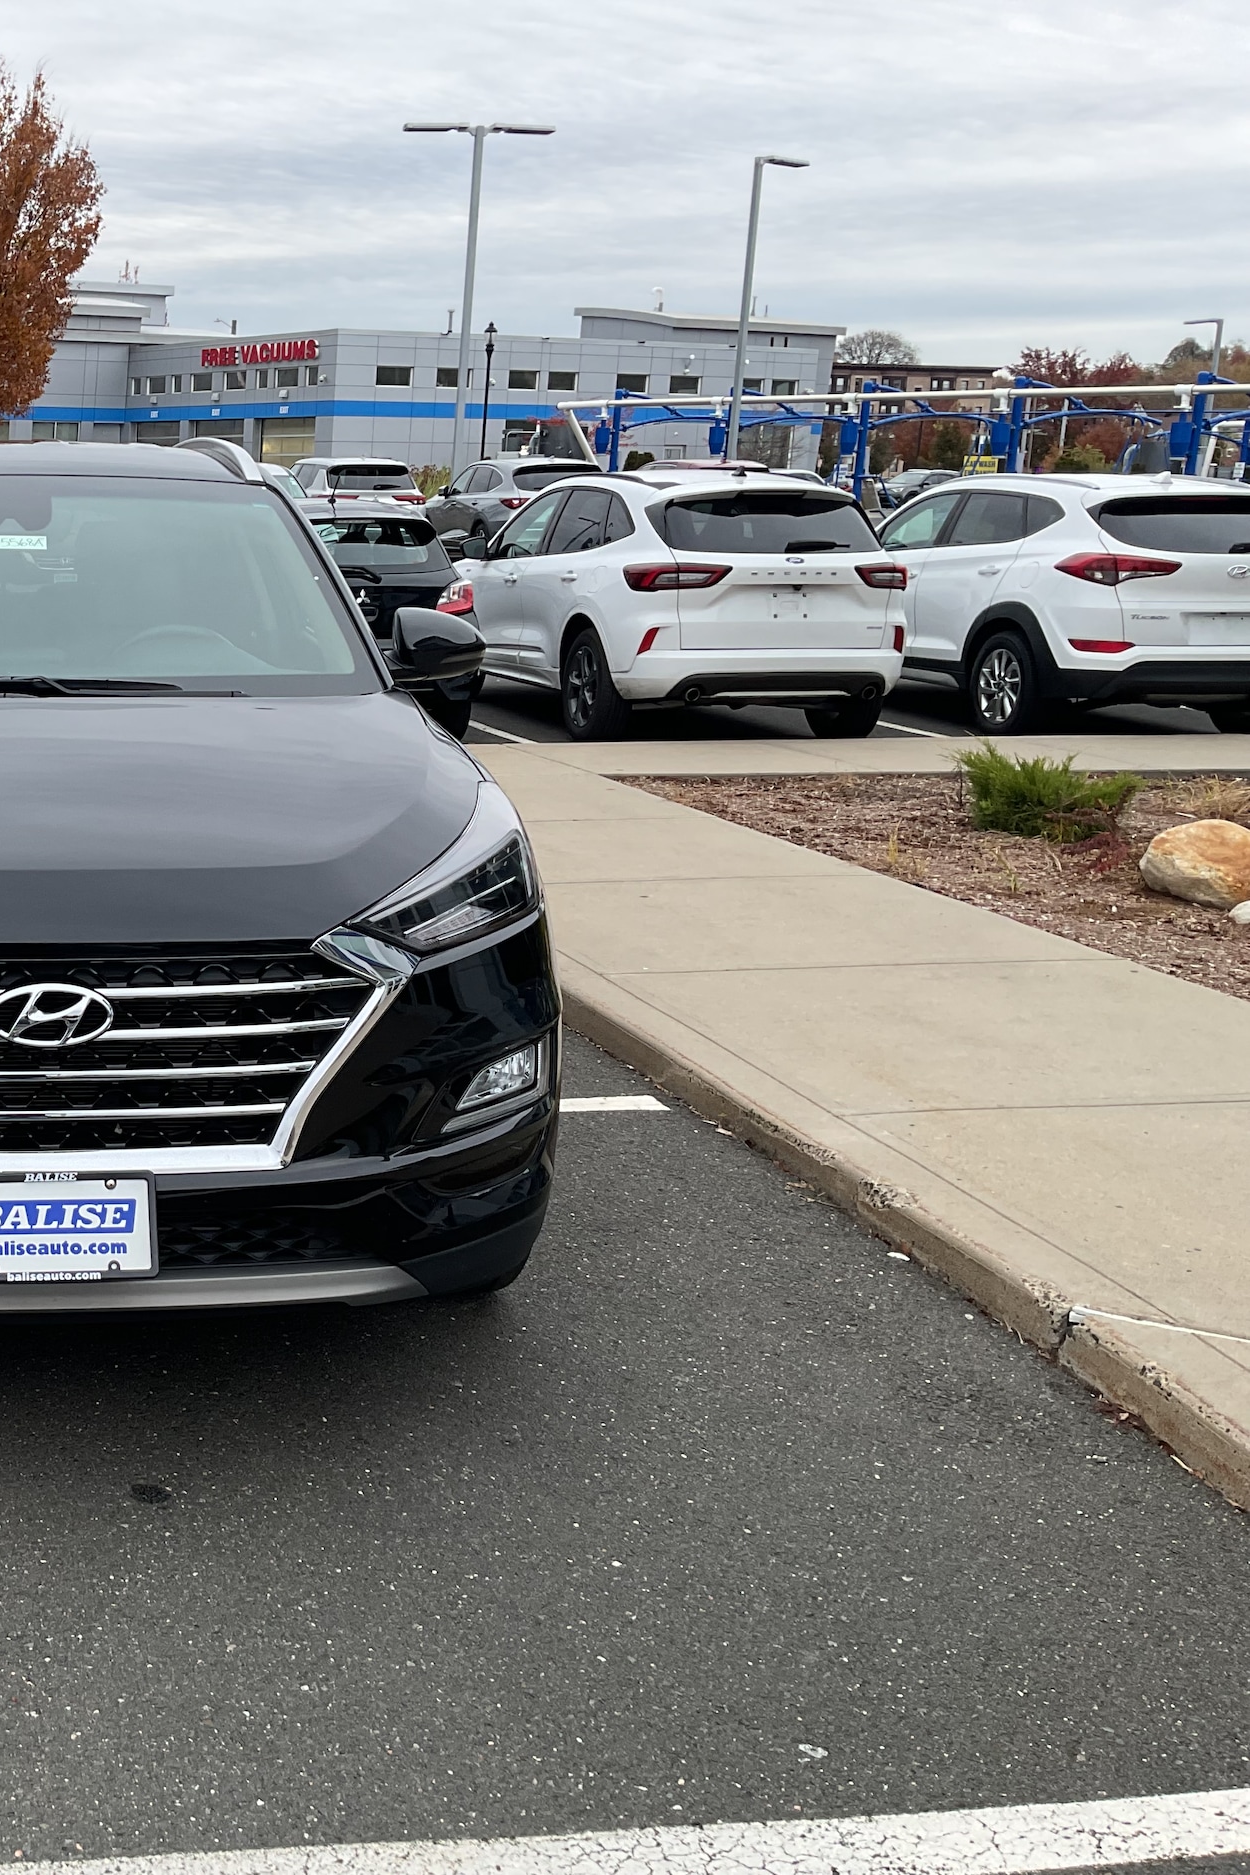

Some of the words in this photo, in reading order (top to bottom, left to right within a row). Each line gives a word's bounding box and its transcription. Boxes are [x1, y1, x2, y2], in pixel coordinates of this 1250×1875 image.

[201, 346, 240, 367] FREE
[240, 338, 319, 364] VACUUMS
[24, 1172, 78, 1182] BALISE
[6, 1270, 102, 1283] baliseauto.com
